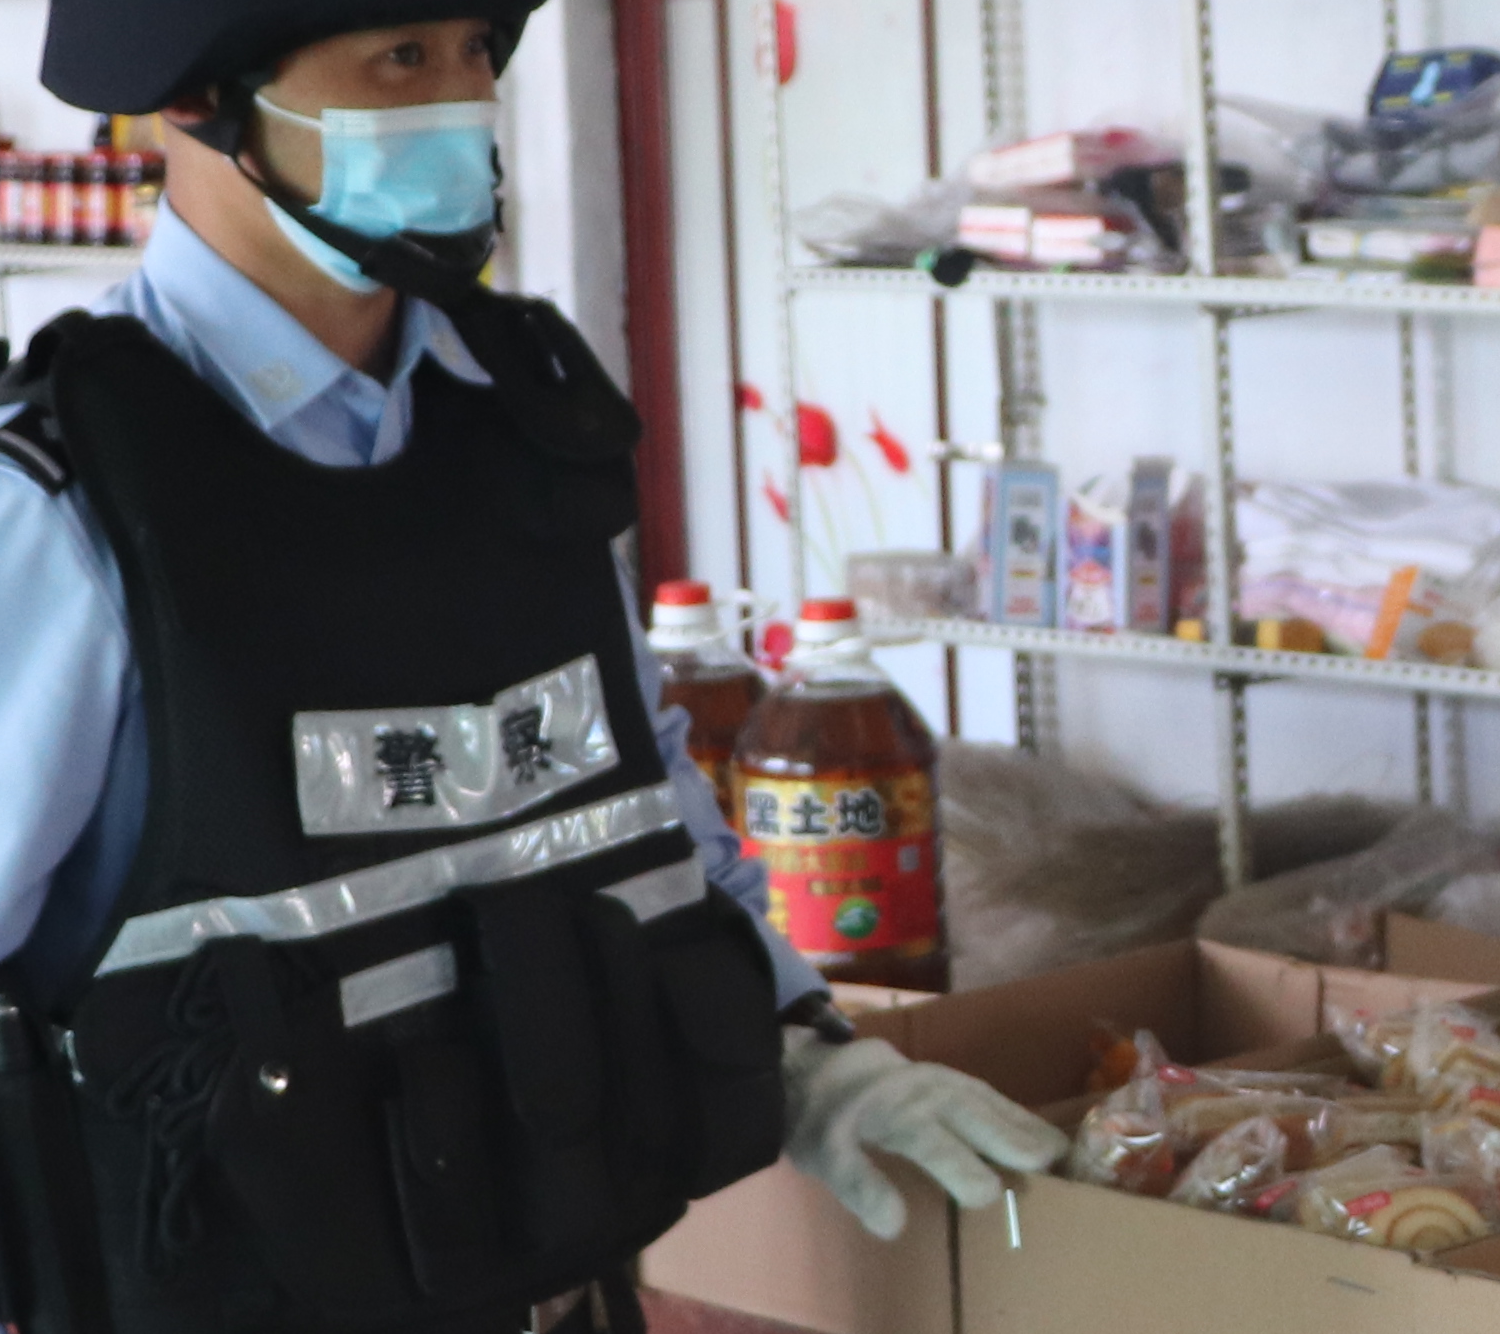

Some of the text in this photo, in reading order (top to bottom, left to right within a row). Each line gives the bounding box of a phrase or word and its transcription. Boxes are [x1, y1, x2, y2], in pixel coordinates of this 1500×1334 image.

[373, 705, 554, 809] 警察
[745, 785, 884, 837] 黑土地
